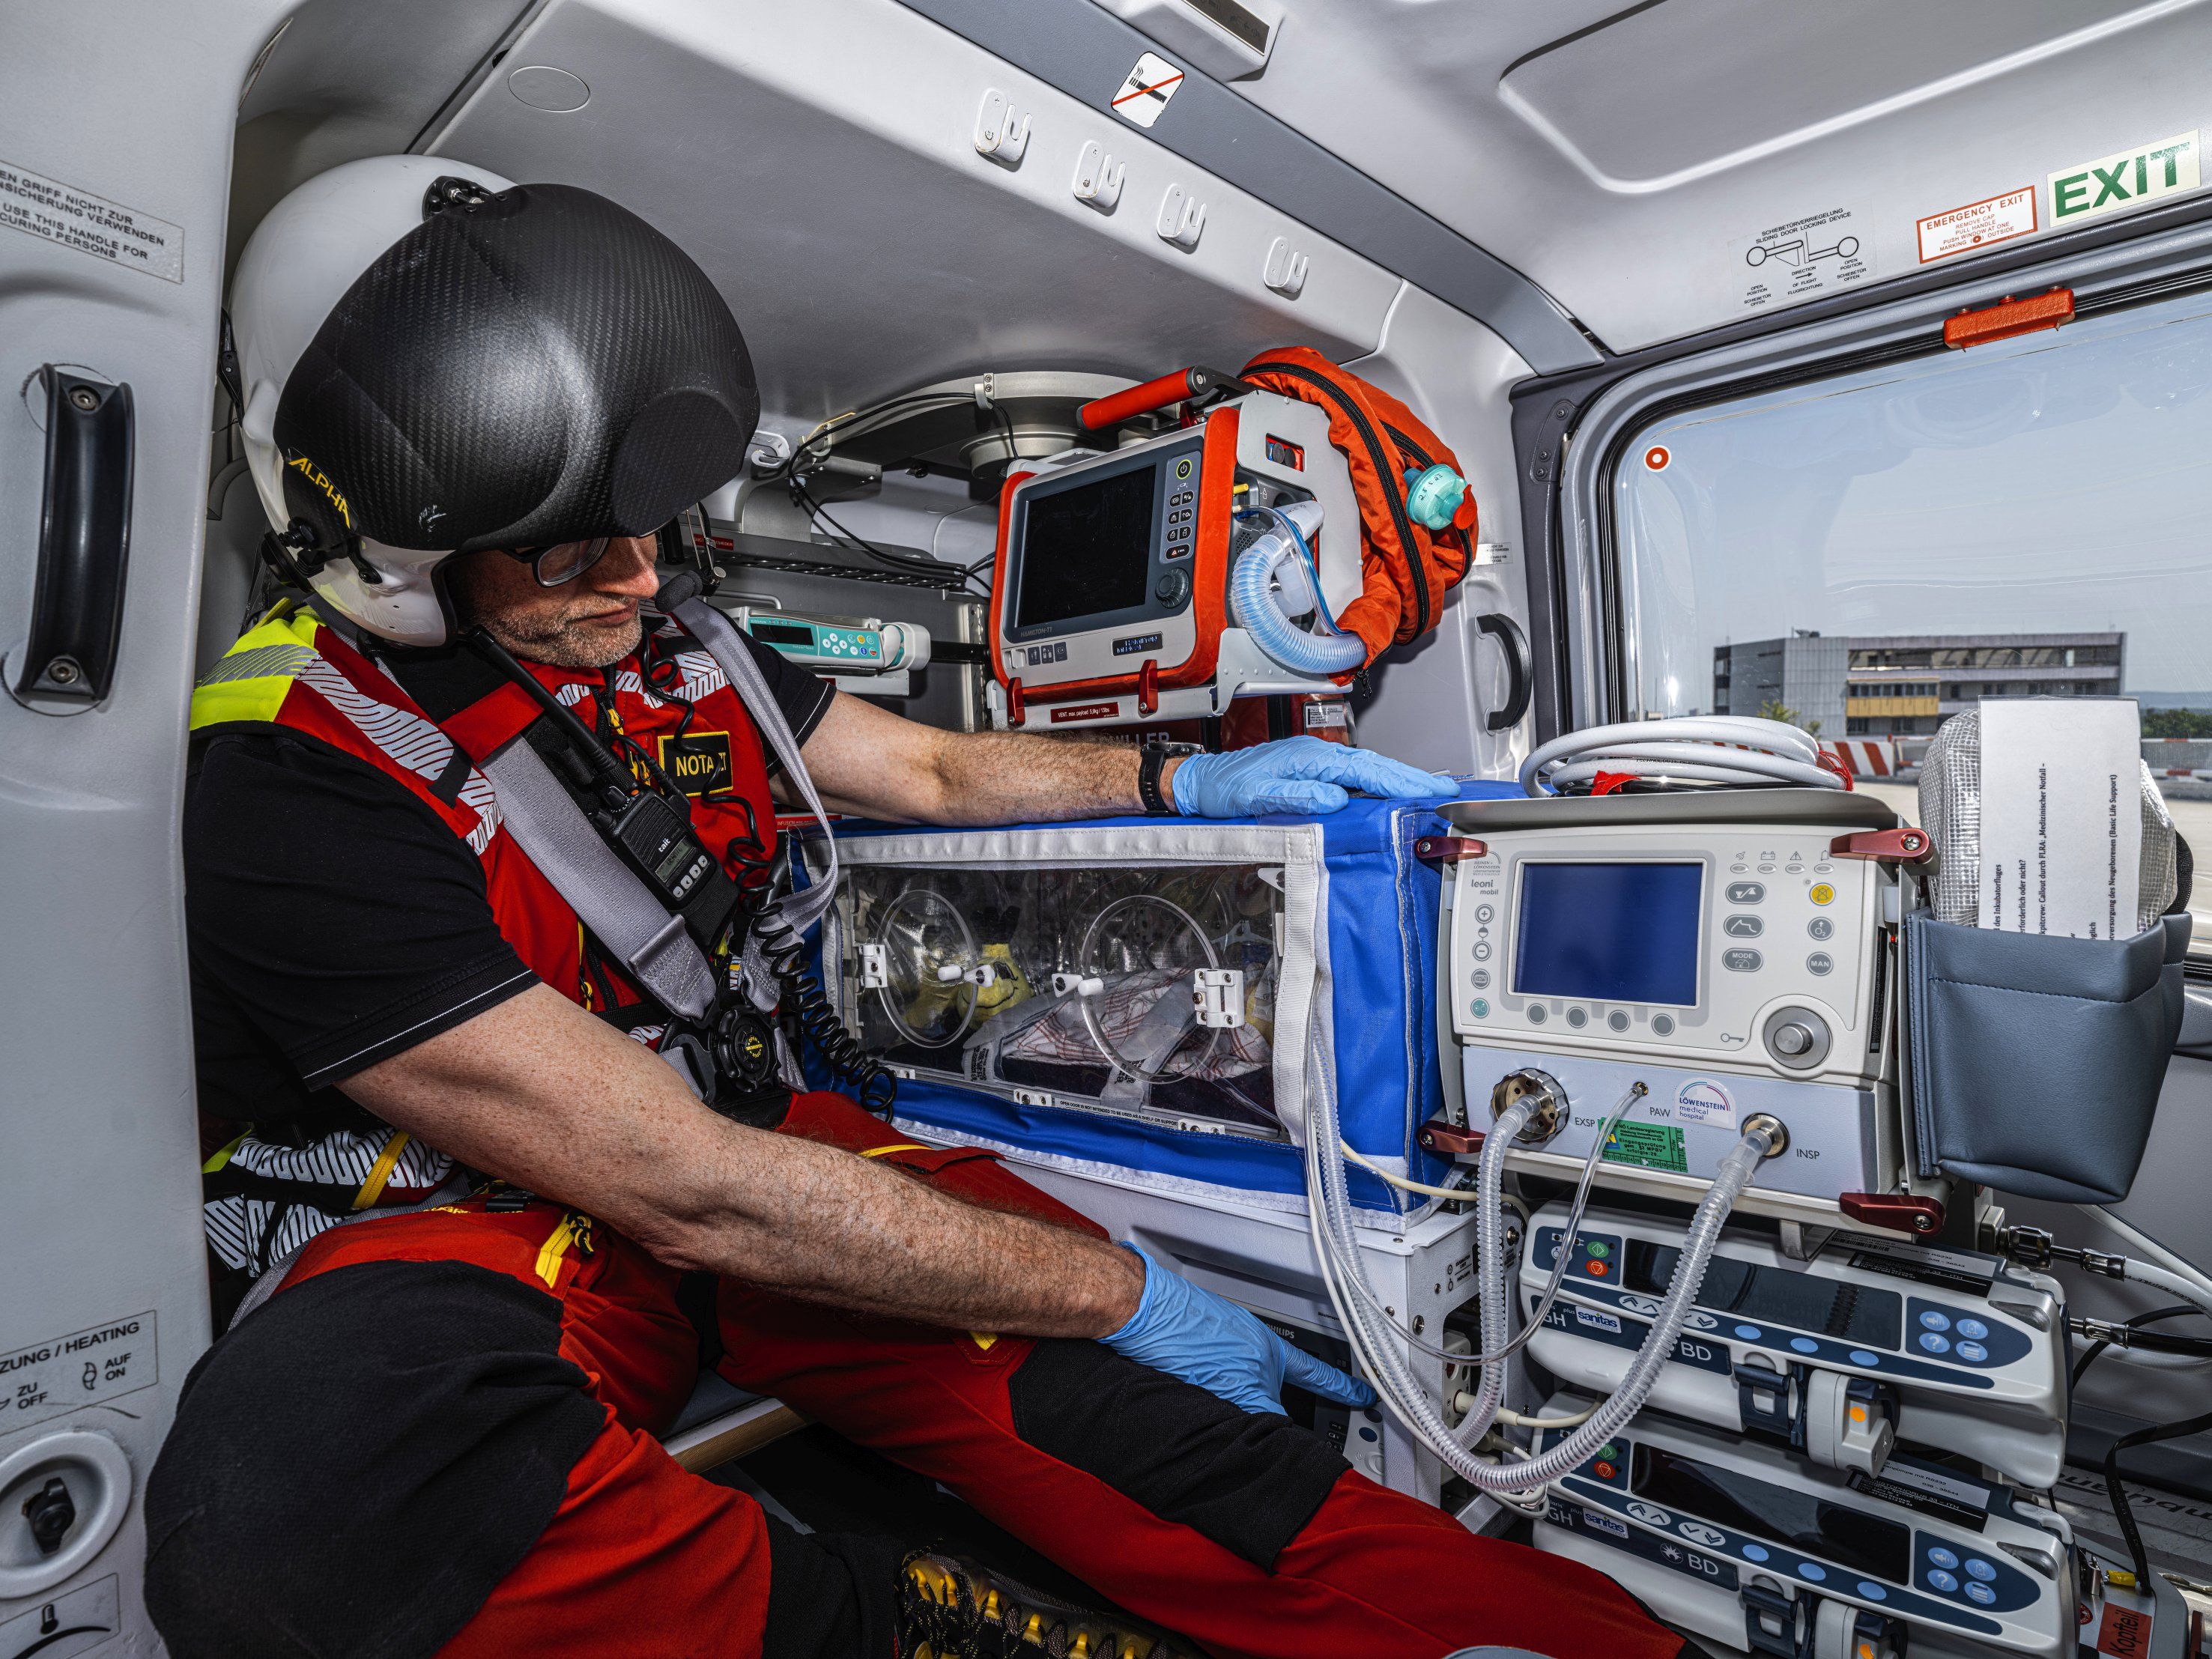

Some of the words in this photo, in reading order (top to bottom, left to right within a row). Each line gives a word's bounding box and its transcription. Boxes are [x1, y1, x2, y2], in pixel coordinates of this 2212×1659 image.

[2054, 142, 2190, 219] EXIT
[22, 178, 61, 198] GRIFF
[66, 195, 105, 214] NICHT
[109, 210, 133, 225] ZUR
[1762, 207, 1843, 236] SCHIEBETÜRVERRIEGELUNG
[1927, 204, 1993, 230] EMERGENCY
[2000, 194, 2023, 208] EXIT
[1956, 217, 1981, 228] REMOVE
[1982, 213, 1995, 222] CAP
[3, 202, 30, 219] USE
[34, 213, 64, 231] THIS
[69, 225, 119, 249] HANDLE
[123, 245, 148, 260] FOR
[88, 213, 165, 246] VERWENDEN
[1756, 234, 1778, 244] SLIDING
[1781, 227, 1798, 237] DOOR
[1801, 219, 1827, 231] LOCKING
[1829, 211, 1852, 222] DEVICE
[1956, 227, 1970, 235] PULL
[1972, 219, 1996, 231] HANDLE
[55, 231, 117, 258] PERSONS
[1939, 240, 1967, 252] MARKING
[1987, 226, 2014, 237] OUTSIDE
[1943, 237, 1959, 245] PUSH
[1961, 229, 1987, 240] WINDOW
[1791, 266, 1816, 276] DIRECTION
[1840, 261, 1863, 270] POSITION
[1787, 282, 1823, 295] FLUGRICHTUNG
[1801, 278, 1817, 286] FLIGHT
[288, 457, 351, 529] ALPHA
[1021, 626, 1052, 637] HAMILTON-T1
[1076, 709, 1089, 718] payload
[676, 751, 727, 777] NOTAT
[2109, 774, 2118, 803] Support)
[2039, 792, 2047, 839] „Medizinischer
[2109, 817, 2118, 837] (Basic
[658, 838, 671, 852] tait
[2038, 860, 2046, 879] durch
[2108, 839, 2117, 886] Neugeborenen
[1471, 879, 1493, 888] leoni
[1993, 864, 2002, 915] Inkubatorfluges
[2109, 900, 2117, 941] tversorgung
[1650, 1107, 1670, 1117] PAW
[1679, 1097, 1726, 1111] LÖWENSTEIN
[1679, 1106, 1709, 1115] medical
[1575, 1117, 1596, 1128] EXSP
[1679, 1111, 1704, 1120] hospital
[1796, 1148, 1820, 1159] INSP
[1578, 1311, 1618, 1328] sanitas
[0, 1348, 50, 1374] ZUNG
[65, 1321, 141, 1353] HEATING
[1680, 1341, 1712, 1362] BD
[105, 1353, 133, 1370] AUF
[106, 1366, 126, 1381] ON
[17, 1382, 39, 1397] ZU
[18, 1392, 49, 1410] OFF
[1548, 1507, 1573, 1527] GH
[1585, 1512, 1625, 1533] sanitas
[1688, 1553, 1719, 1576] BD
[2109, 1609, 2142, 1658] Kopfteil
